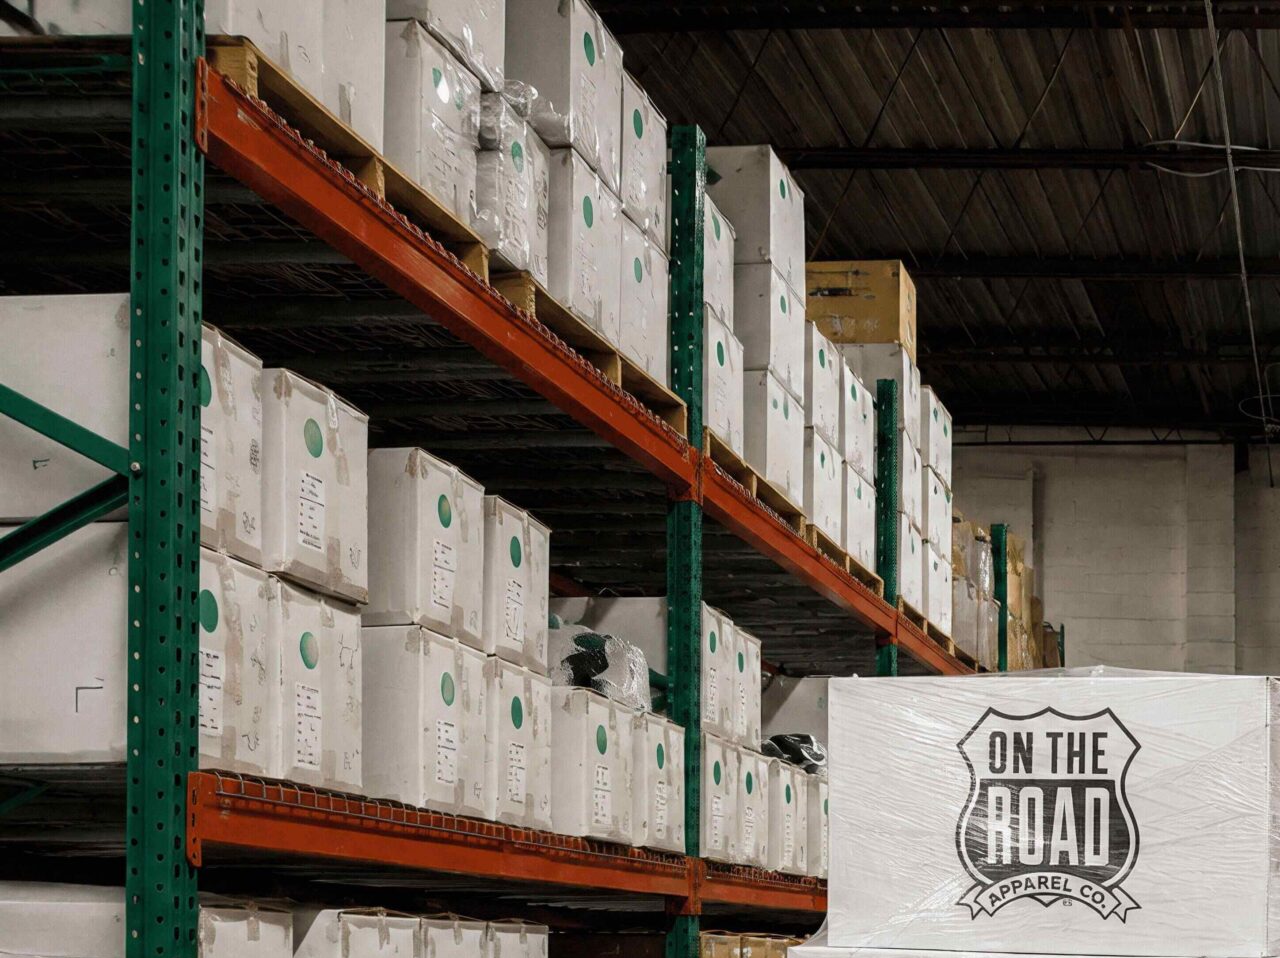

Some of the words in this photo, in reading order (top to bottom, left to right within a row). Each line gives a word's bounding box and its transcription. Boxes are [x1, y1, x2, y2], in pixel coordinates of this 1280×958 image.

[988, 730, 1034, 775] ON
[1045, 731, 1109, 775] THE
[987, 786, 1110, 866] ROAD
[988, 875, 1073, 908] APPAREL
[1079, 884, 1109, 909] CO.
